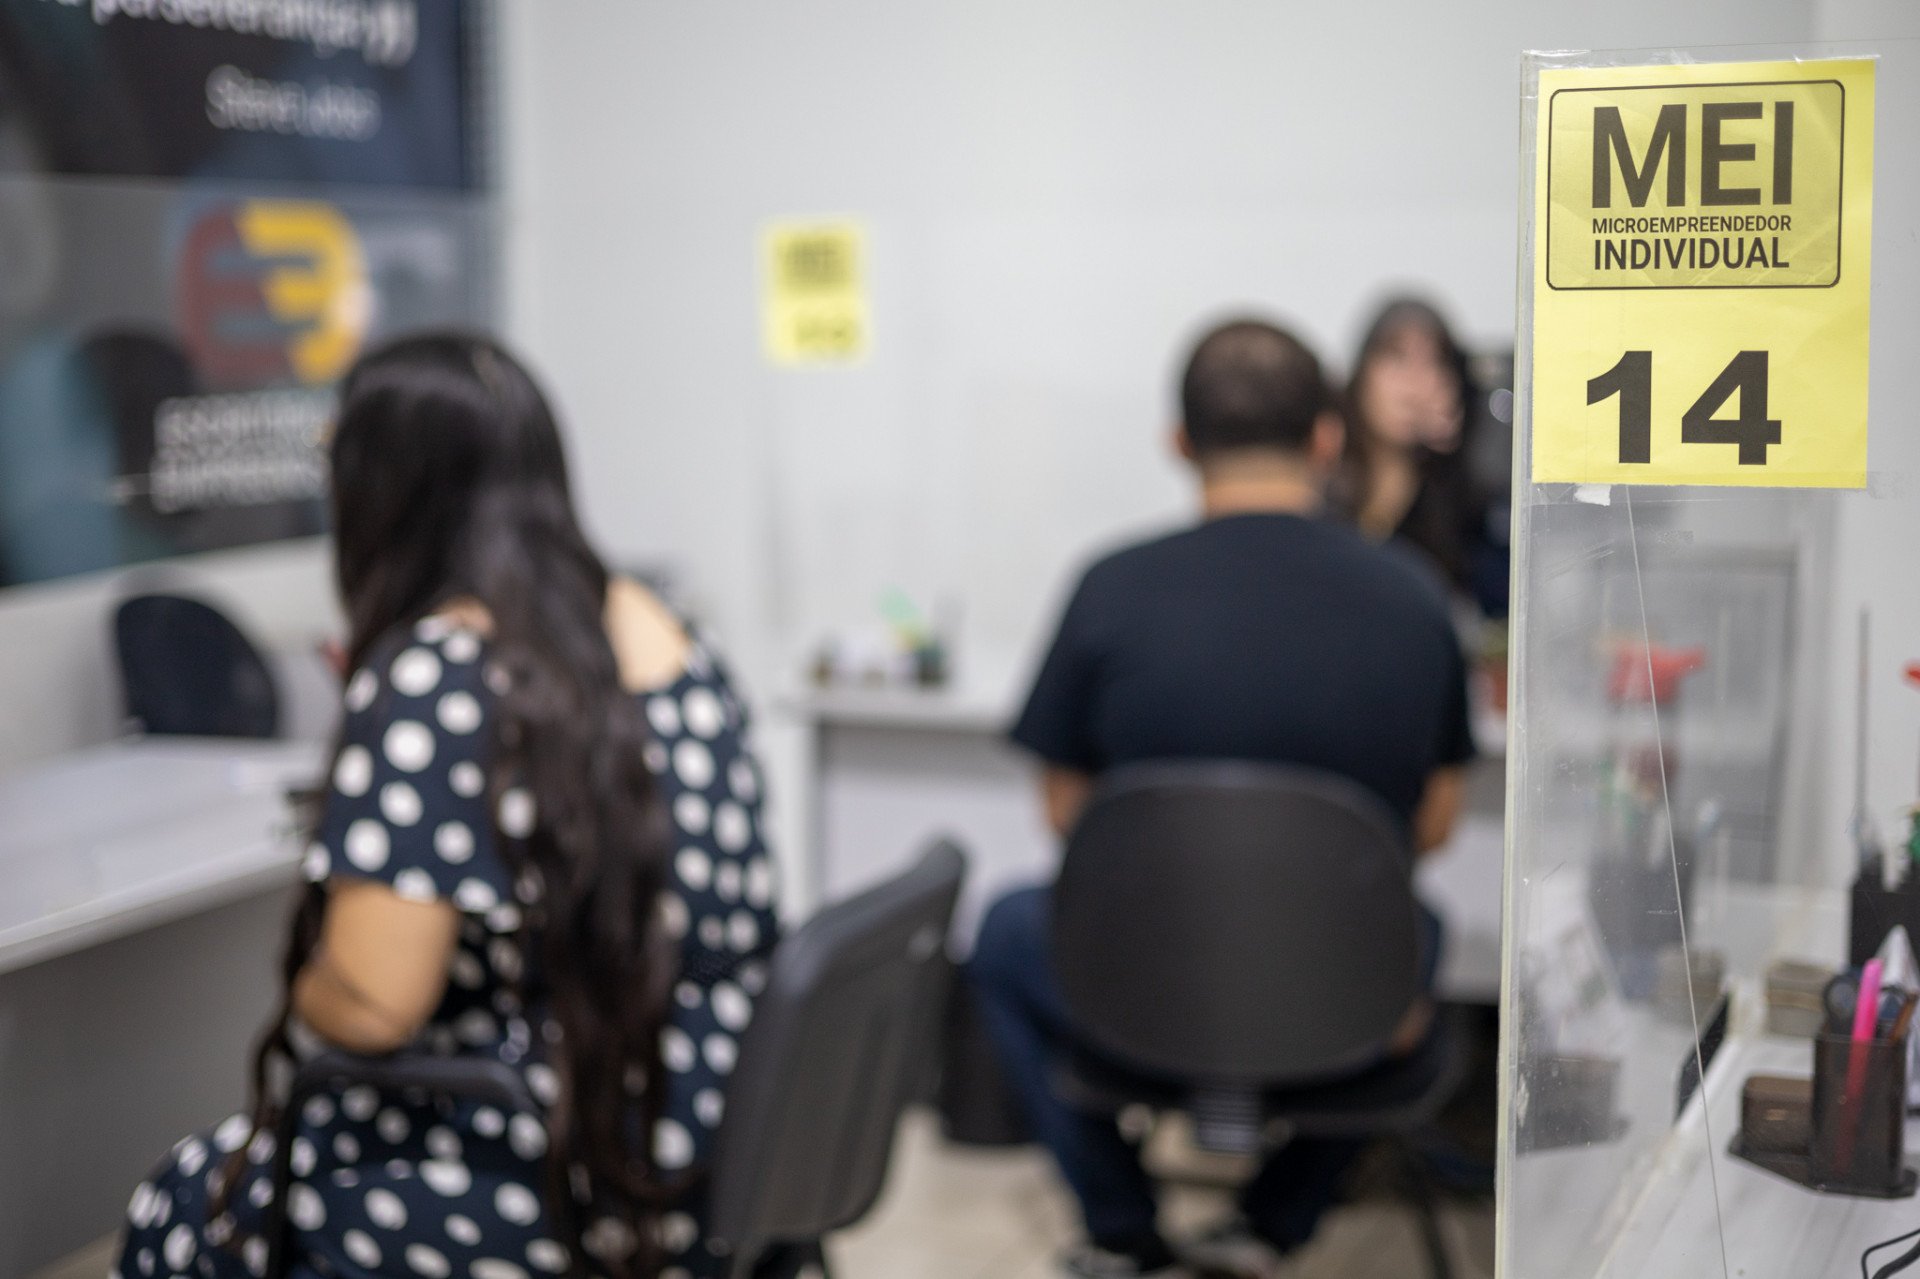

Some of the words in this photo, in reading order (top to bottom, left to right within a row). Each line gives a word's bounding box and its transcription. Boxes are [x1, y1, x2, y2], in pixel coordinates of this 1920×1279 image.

[1591, 101, 1794, 209] MEI
[1592, 215, 1792, 235] MICROEMPREENDEDOR
[1594, 236, 1790, 270] INDIVIDUAL
[1586, 350, 1782, 465] 14
